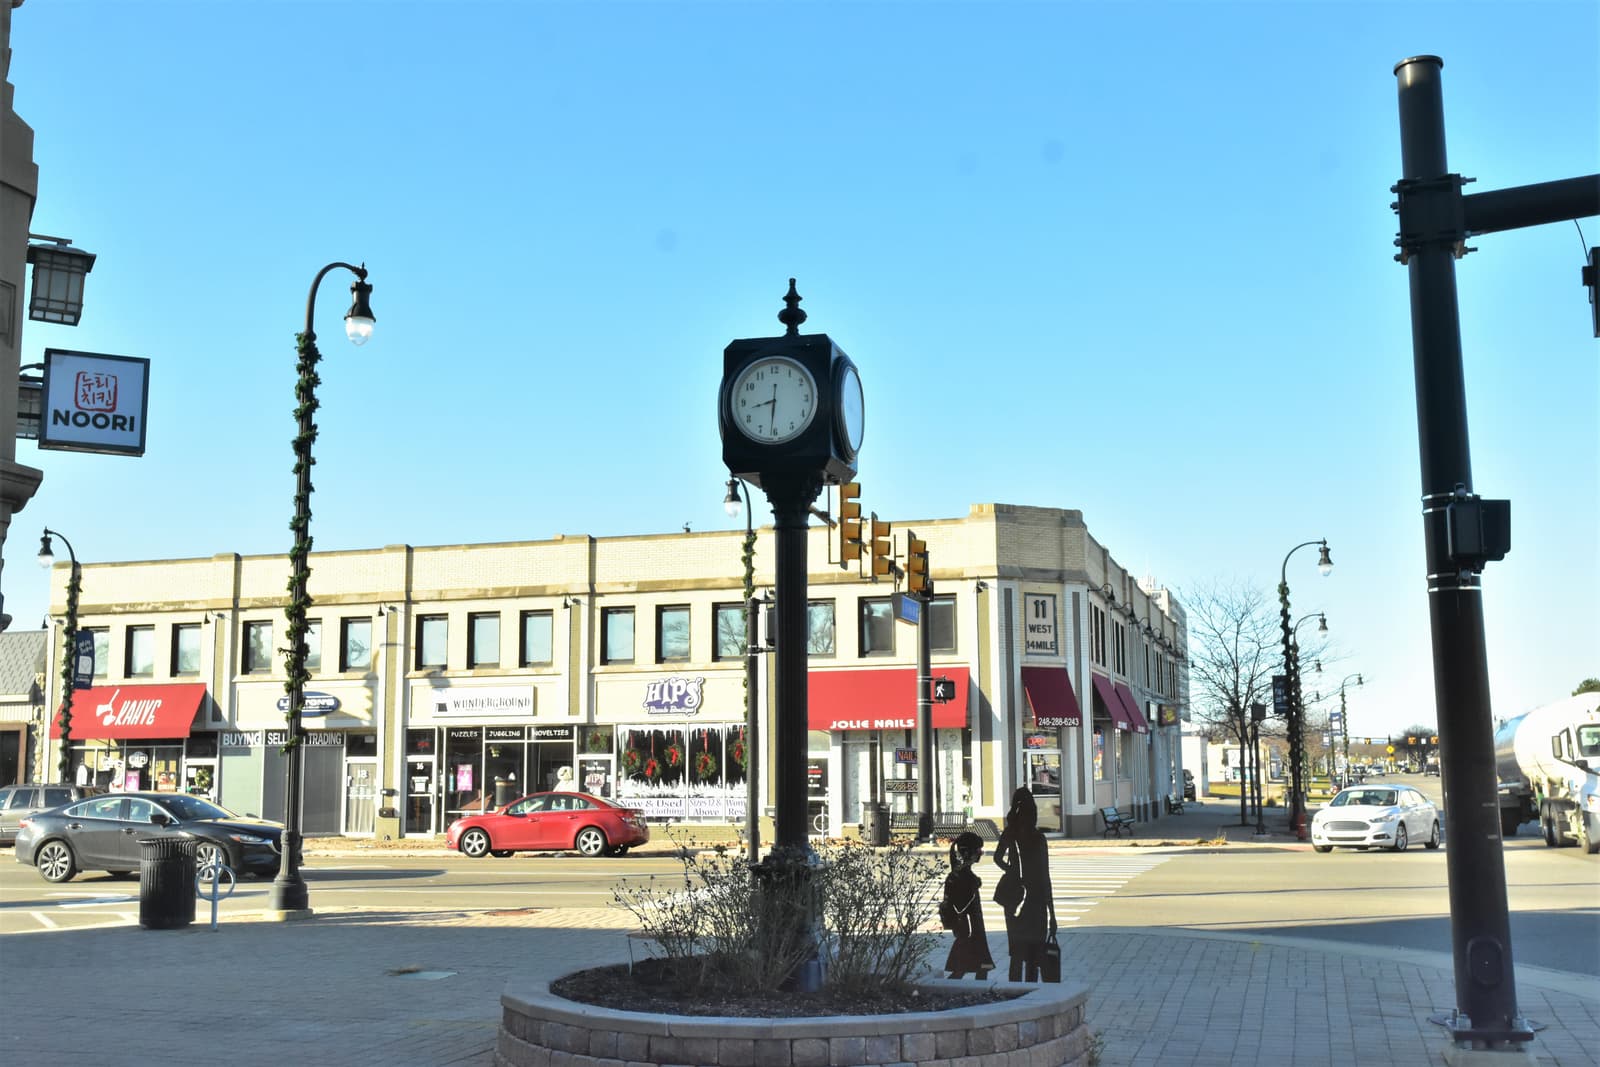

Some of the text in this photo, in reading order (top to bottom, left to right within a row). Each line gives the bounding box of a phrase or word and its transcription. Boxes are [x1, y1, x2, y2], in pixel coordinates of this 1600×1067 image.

[770, 366, 779, 374] 12
[787, 369, 792, 378] 1
[755, 371, 764, 381] 11
[81, 374, 109, 392] 누리
[745, 383, 755, 391] 10
[798, 378, 804, 387] 2
[81, 388, 113, 407] 치킨
[741, 399, 746, 407] 9
[53, 408, 135, 432] NOORI
[746, 415, 752, 423] 8
[773, 428, 778, 436] 6
[1033, 600, 1046, 618] 11
[1028, 624, 1052, 634] WEST
[643, 676, 704, 708] HIPS
[830, 719, 915, 729] JOLIE NAILS
[1038, 717, 1080, 726] 248-288-6243
[532, 729, 569, 737] NOVELTIES
[222, 733, 261, 746] BUYING
[308, 732, 342, 745] TRADING
[645, 799, 653, 808] &
[656, 799, 682, 808] Used
[695, 807, 720, 816] Above
